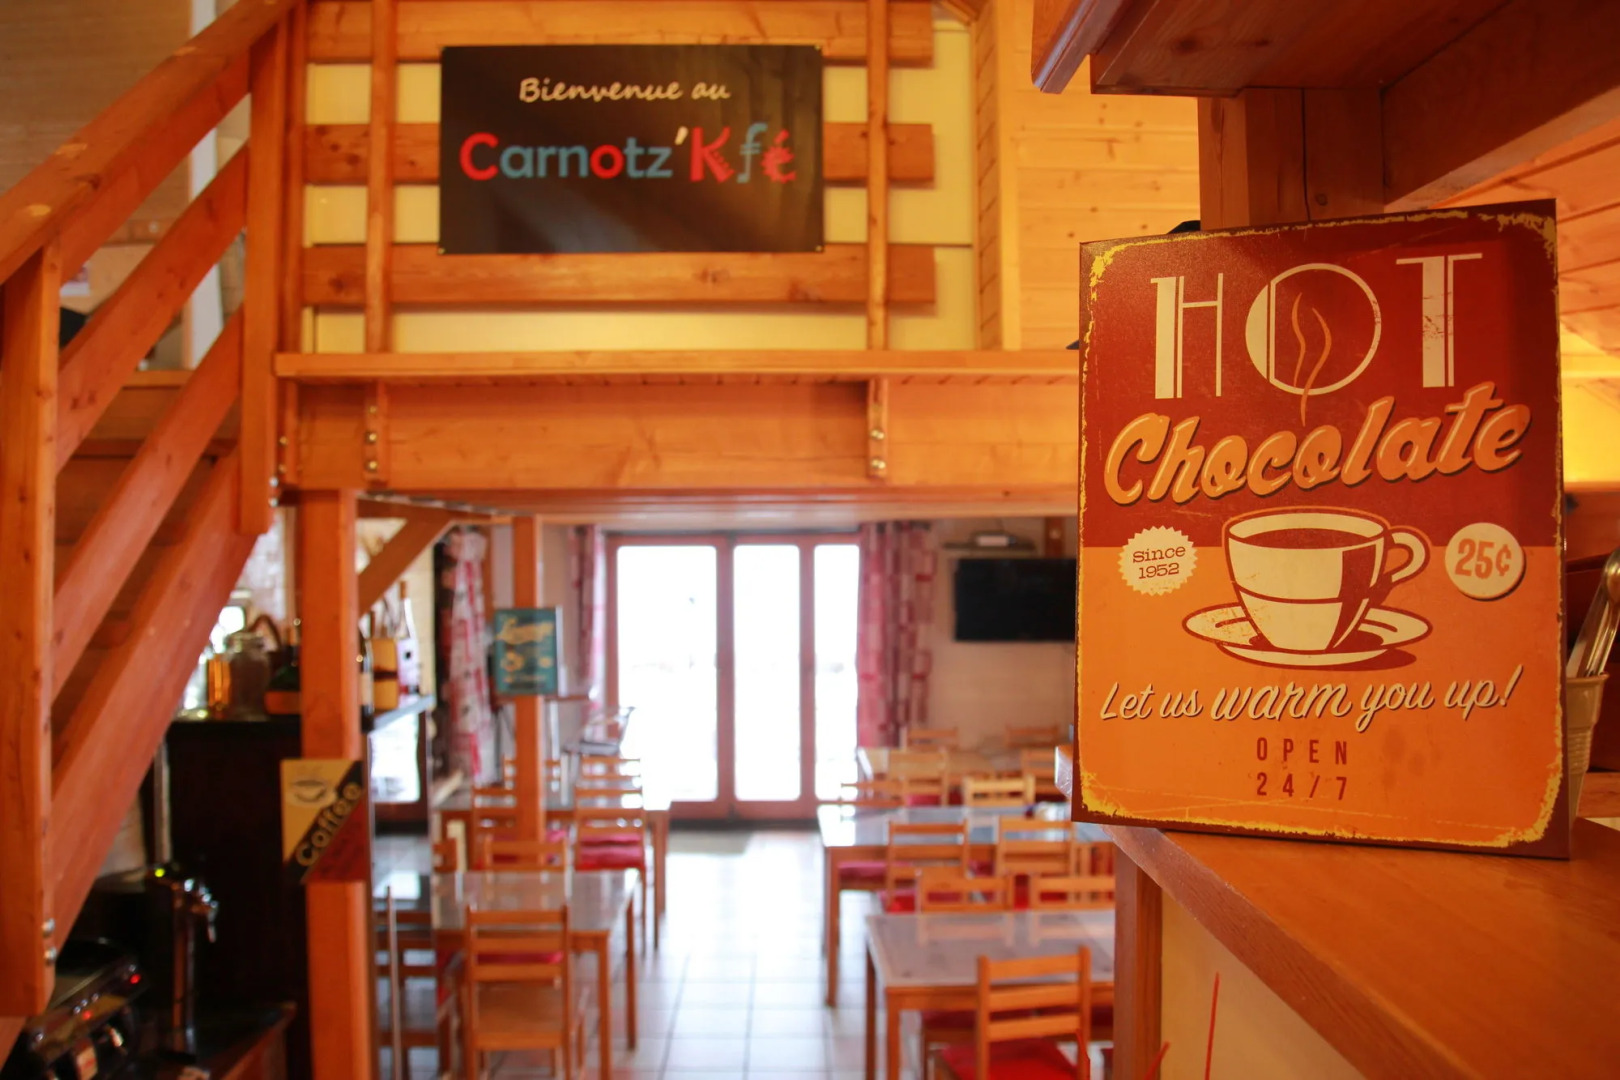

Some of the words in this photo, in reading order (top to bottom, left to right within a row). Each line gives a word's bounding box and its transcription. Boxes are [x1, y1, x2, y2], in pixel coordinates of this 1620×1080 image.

[519, 76, 682, 103] Bienvenue
[690, 81, 731, 100] au
[1150, 252, 1483, 399] HOT
[1103, 381, 1532, 504] Chocolate
[1132, 546, 1186, 563] Since
[1138, 562, 1180, 579] 1952
[1455, 538, 1512, 579] 25¢
[1100, 682, 1154, 720] Let
[1159, 689, 1203, 718] us
[1210, 682, 1352, 721] warm
[1355, 682, 1435, 733] you
[1443, 664, 1524, 721] up!
[1256, 737, 1347, 765] OPEN
[1256, 771, 1347, 800] 24/7
[295, 782, 363, 867] Coffee
